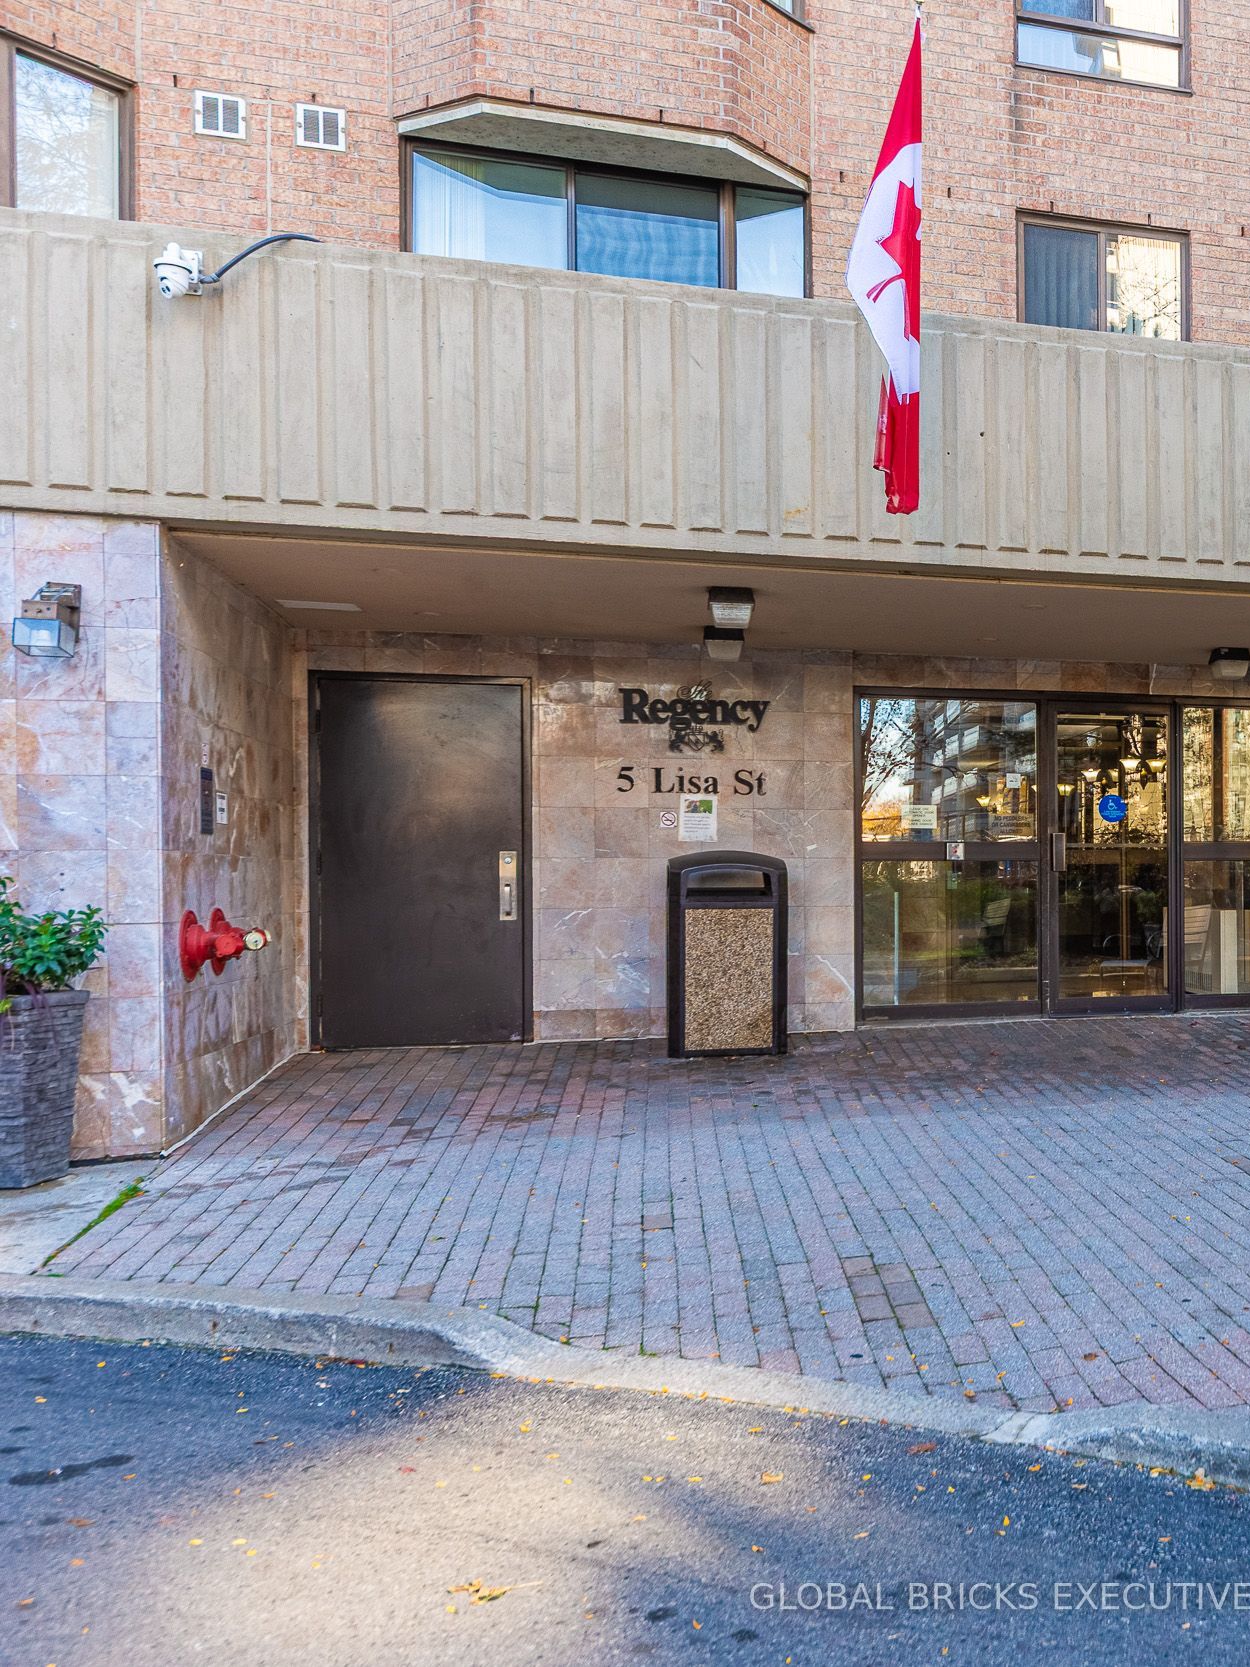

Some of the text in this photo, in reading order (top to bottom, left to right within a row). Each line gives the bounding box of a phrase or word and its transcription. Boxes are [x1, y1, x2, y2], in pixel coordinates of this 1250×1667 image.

[618, 687, 771, 733] Regency
[616, 766, 767, 796] 5 Lisa St
